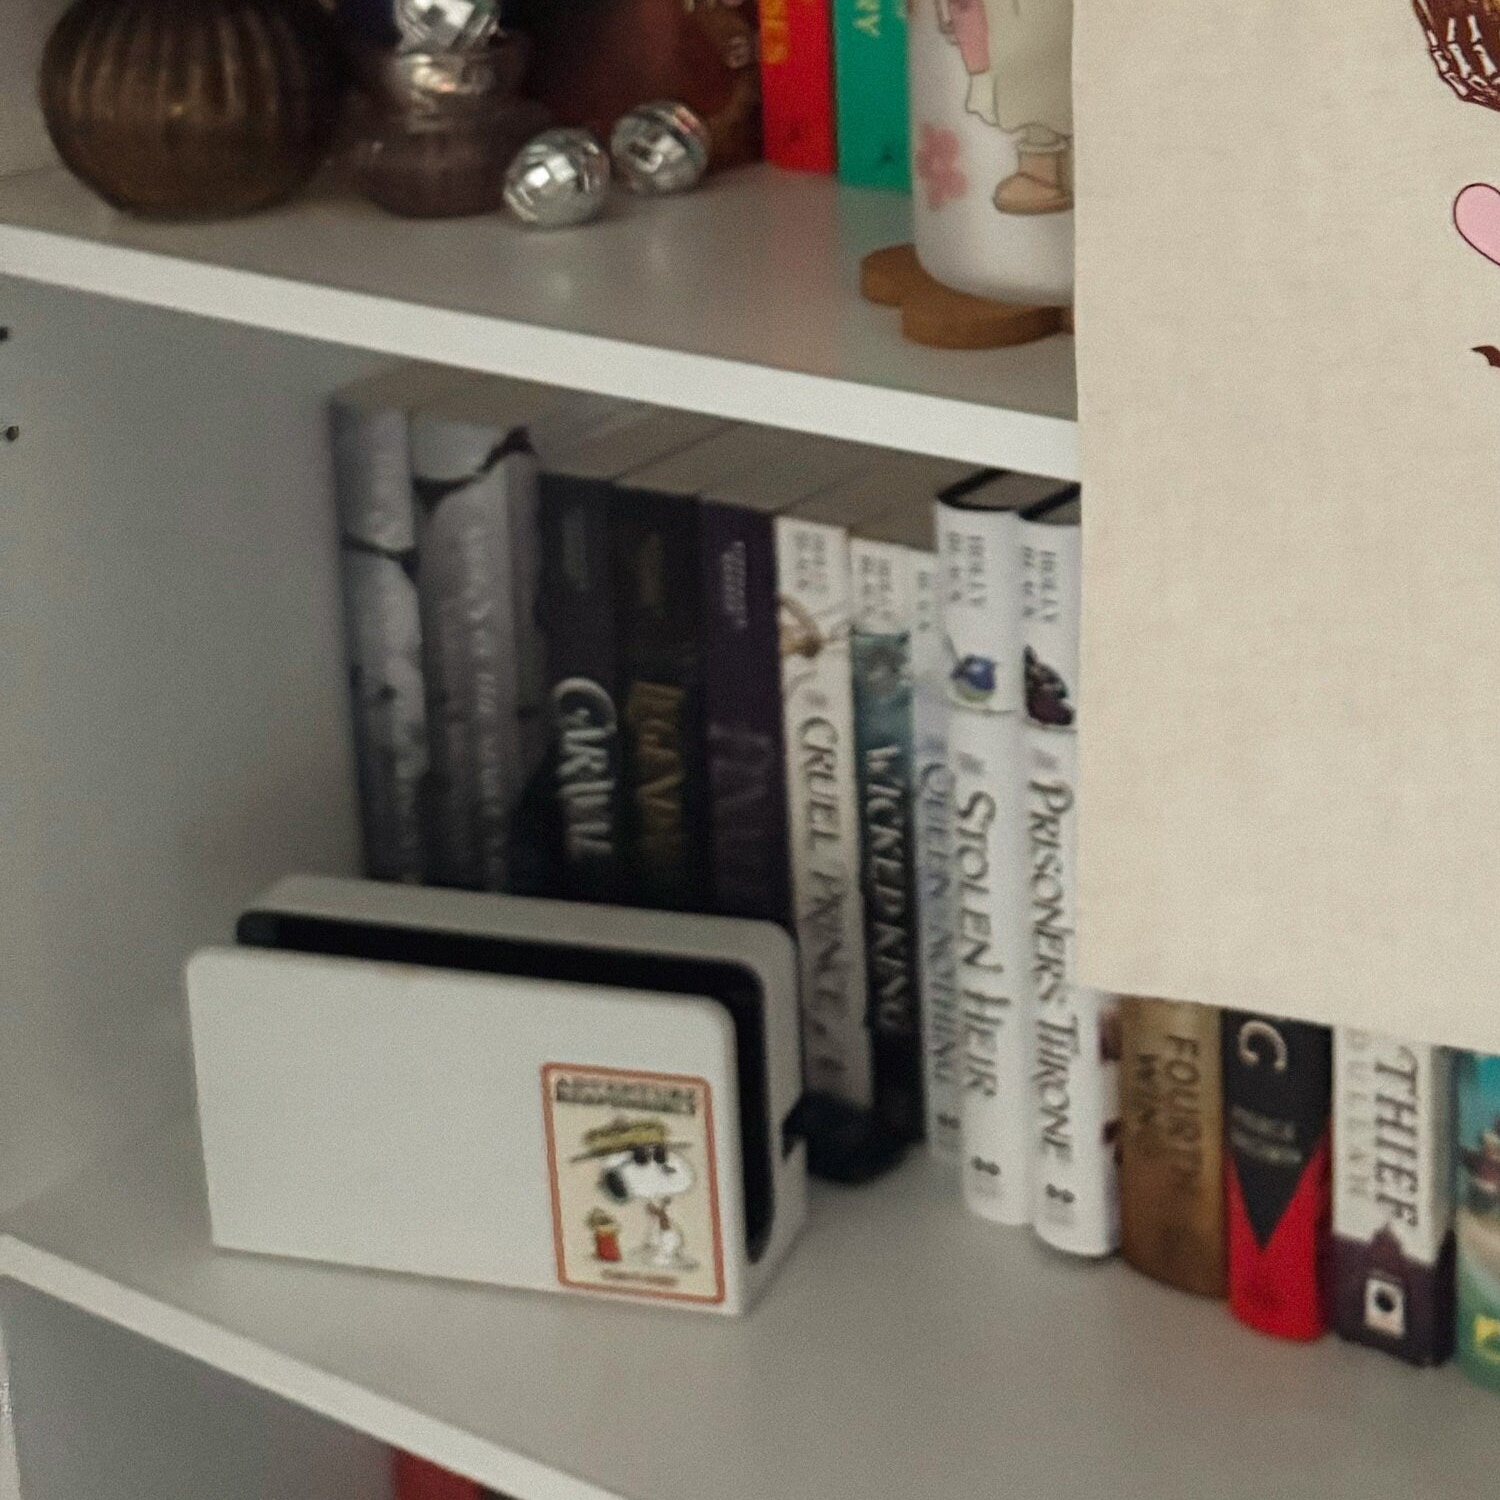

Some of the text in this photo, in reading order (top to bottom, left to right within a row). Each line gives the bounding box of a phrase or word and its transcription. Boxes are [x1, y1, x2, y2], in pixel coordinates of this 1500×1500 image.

[800, 716, 841, 851] CRUEL
[957, 790, 1004, 971] STOLEN
[962, 988, 1011, 1097] HEIR
[1032, 1015, 1081, 1162] THRONE
[1374, 1046, 1419, 1228] THIEF
